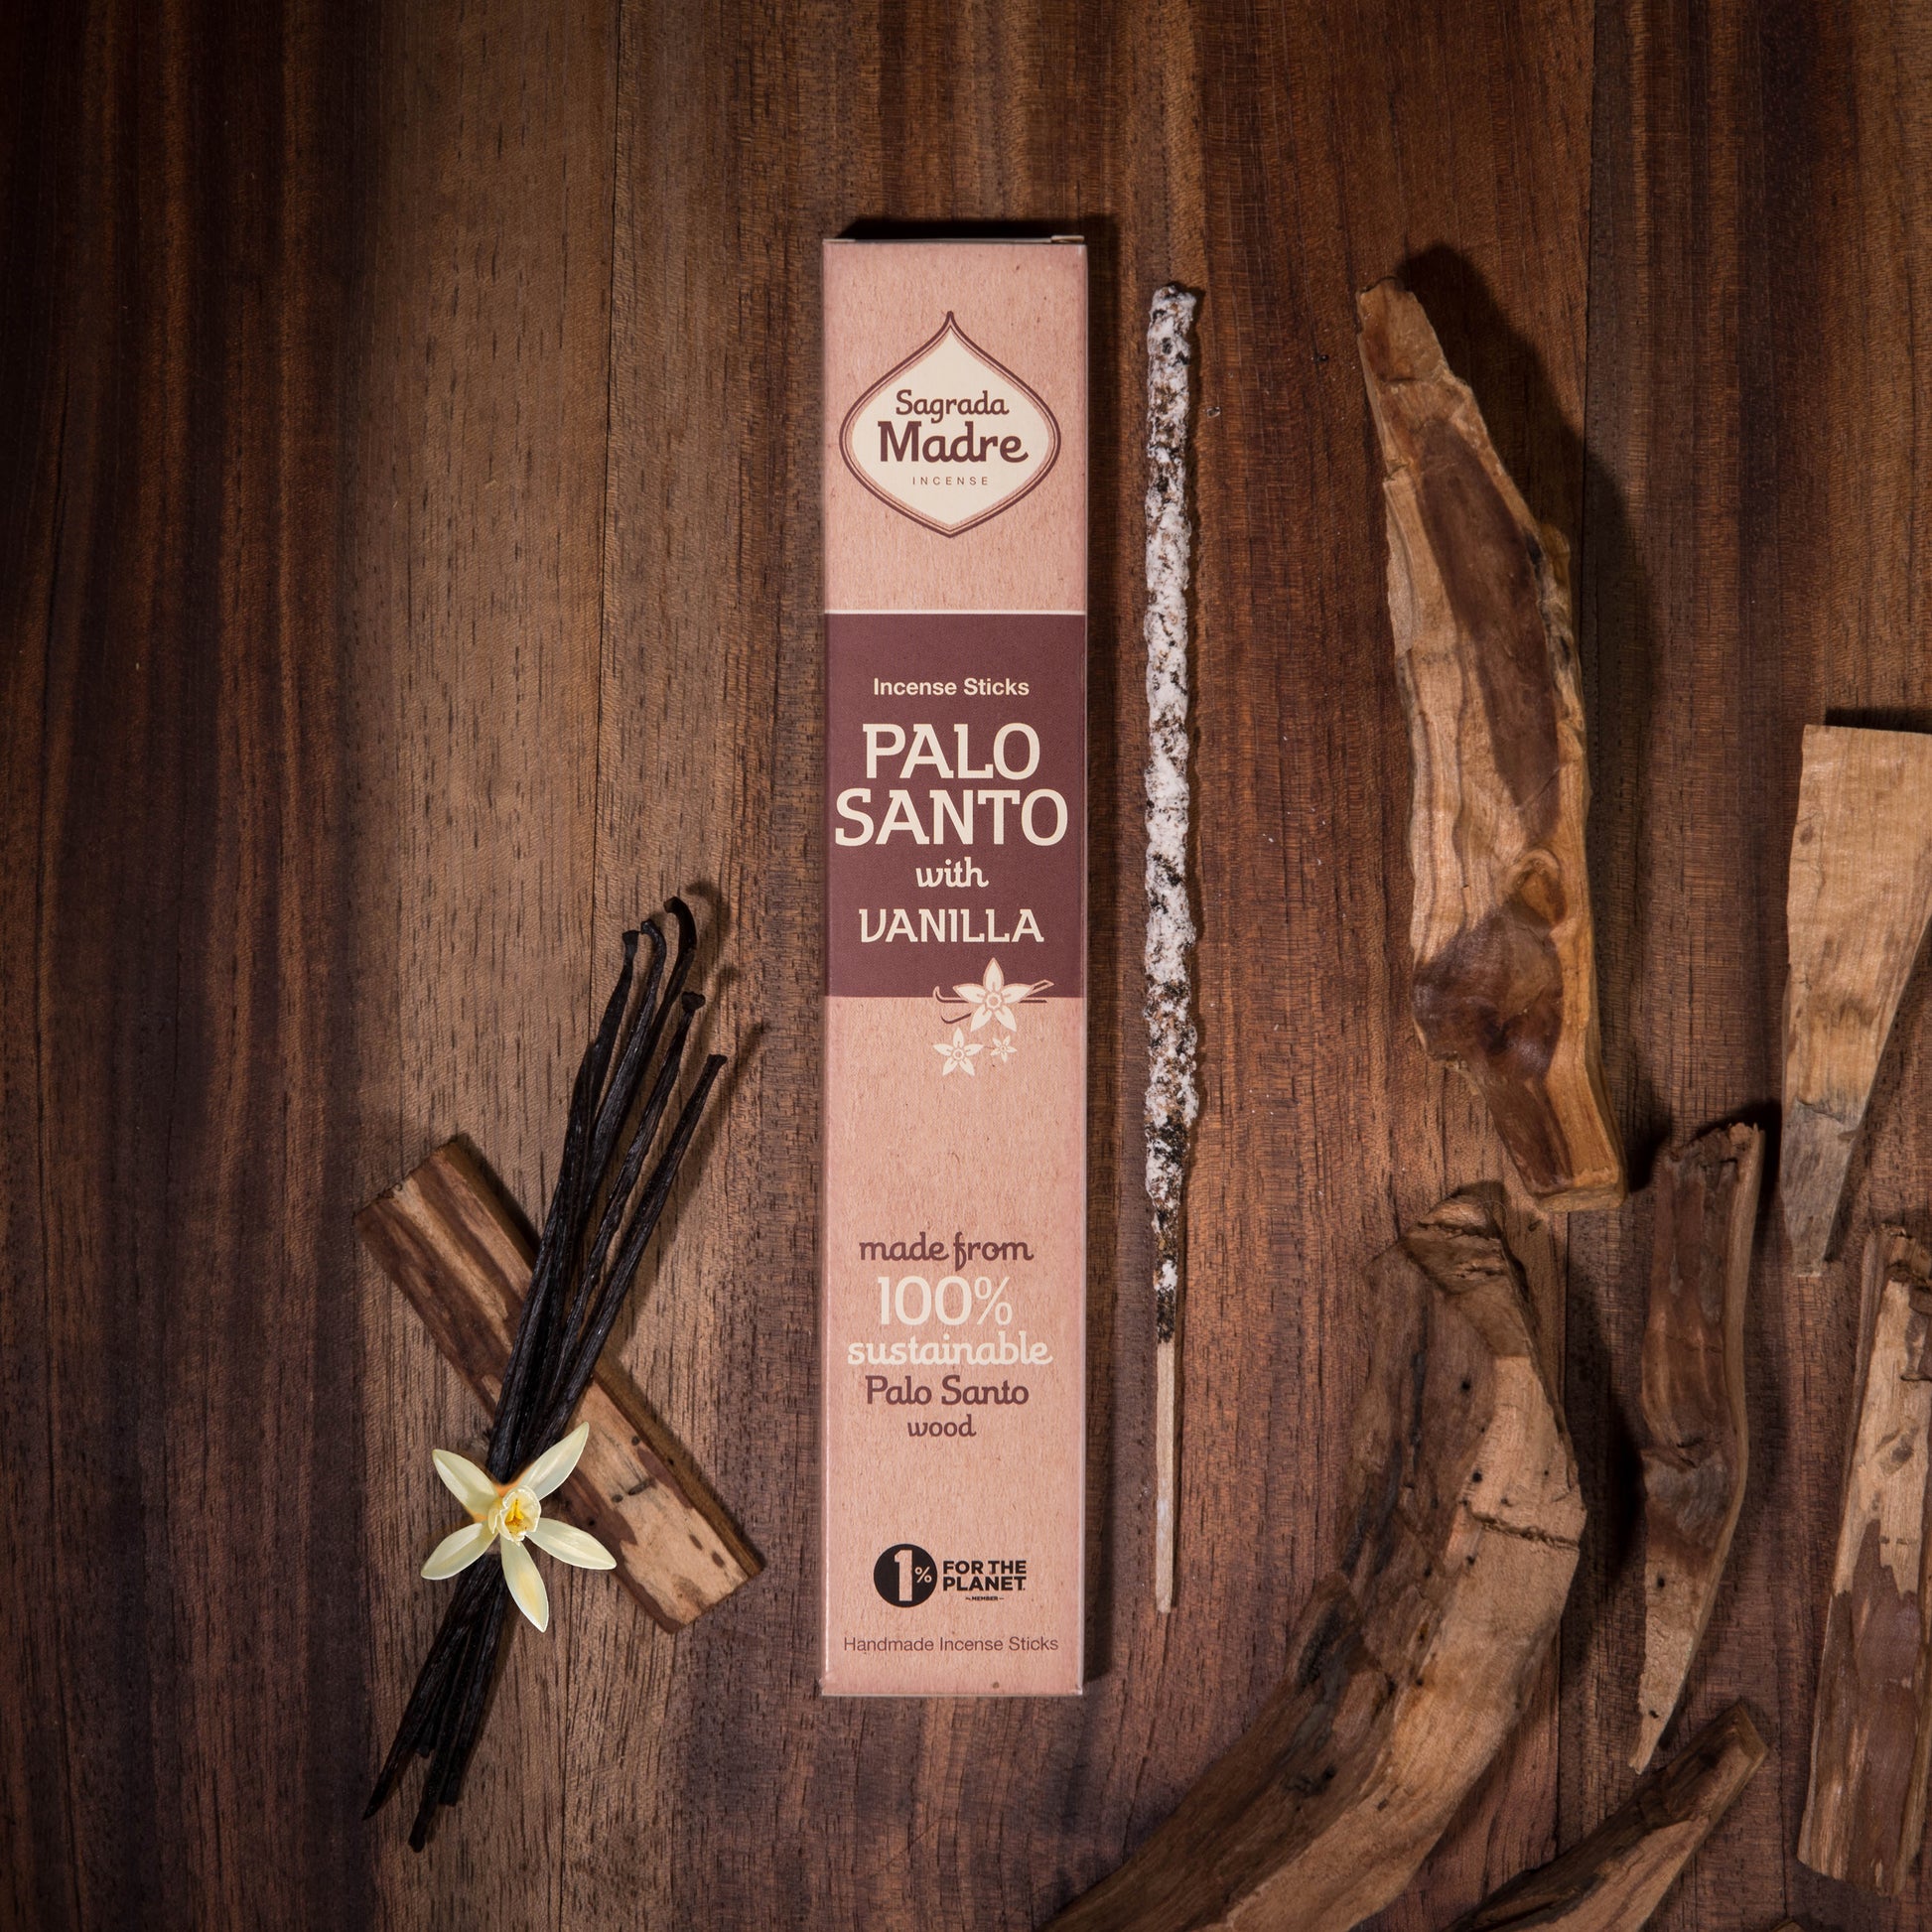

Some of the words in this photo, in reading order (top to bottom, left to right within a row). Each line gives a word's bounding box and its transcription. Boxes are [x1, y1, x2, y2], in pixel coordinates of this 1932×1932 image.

[896, 388, 1010, 424] Sagrada
[878, 420, 1029, 463] Madre
[912, 477, 988, 485] INCENSE
[874, 677, 957, 695] Incense
[963, 677, 1030, 695] Sticks
[862, 723, 1040, 780] PALO
[835, 788, 1068, 846] SANTO
[915, 856, 989, 888] with
[859, 908, 1044, 943] VANILLA
[859, 1231, 949, 1261] made
[953, 1231, 1035, 1272] from
[877, 1276, 1013, 1325] 100%
[847, 1330, 1053, 1366] sustainable
[865, 1375, 932, 1405] Palo
[941, 1374, 1030, 1405] Santo
[907, 1414, 977, 1437] wood
[943, 1561, 984, 1575] FOR
[988, 1561, 1027, 1575] THE
[844, 1637, 934, 1652] Handmade
[939, 1637, 1003, 1652] Incense
[1009, 1637, 1058, 1652] Sticks
